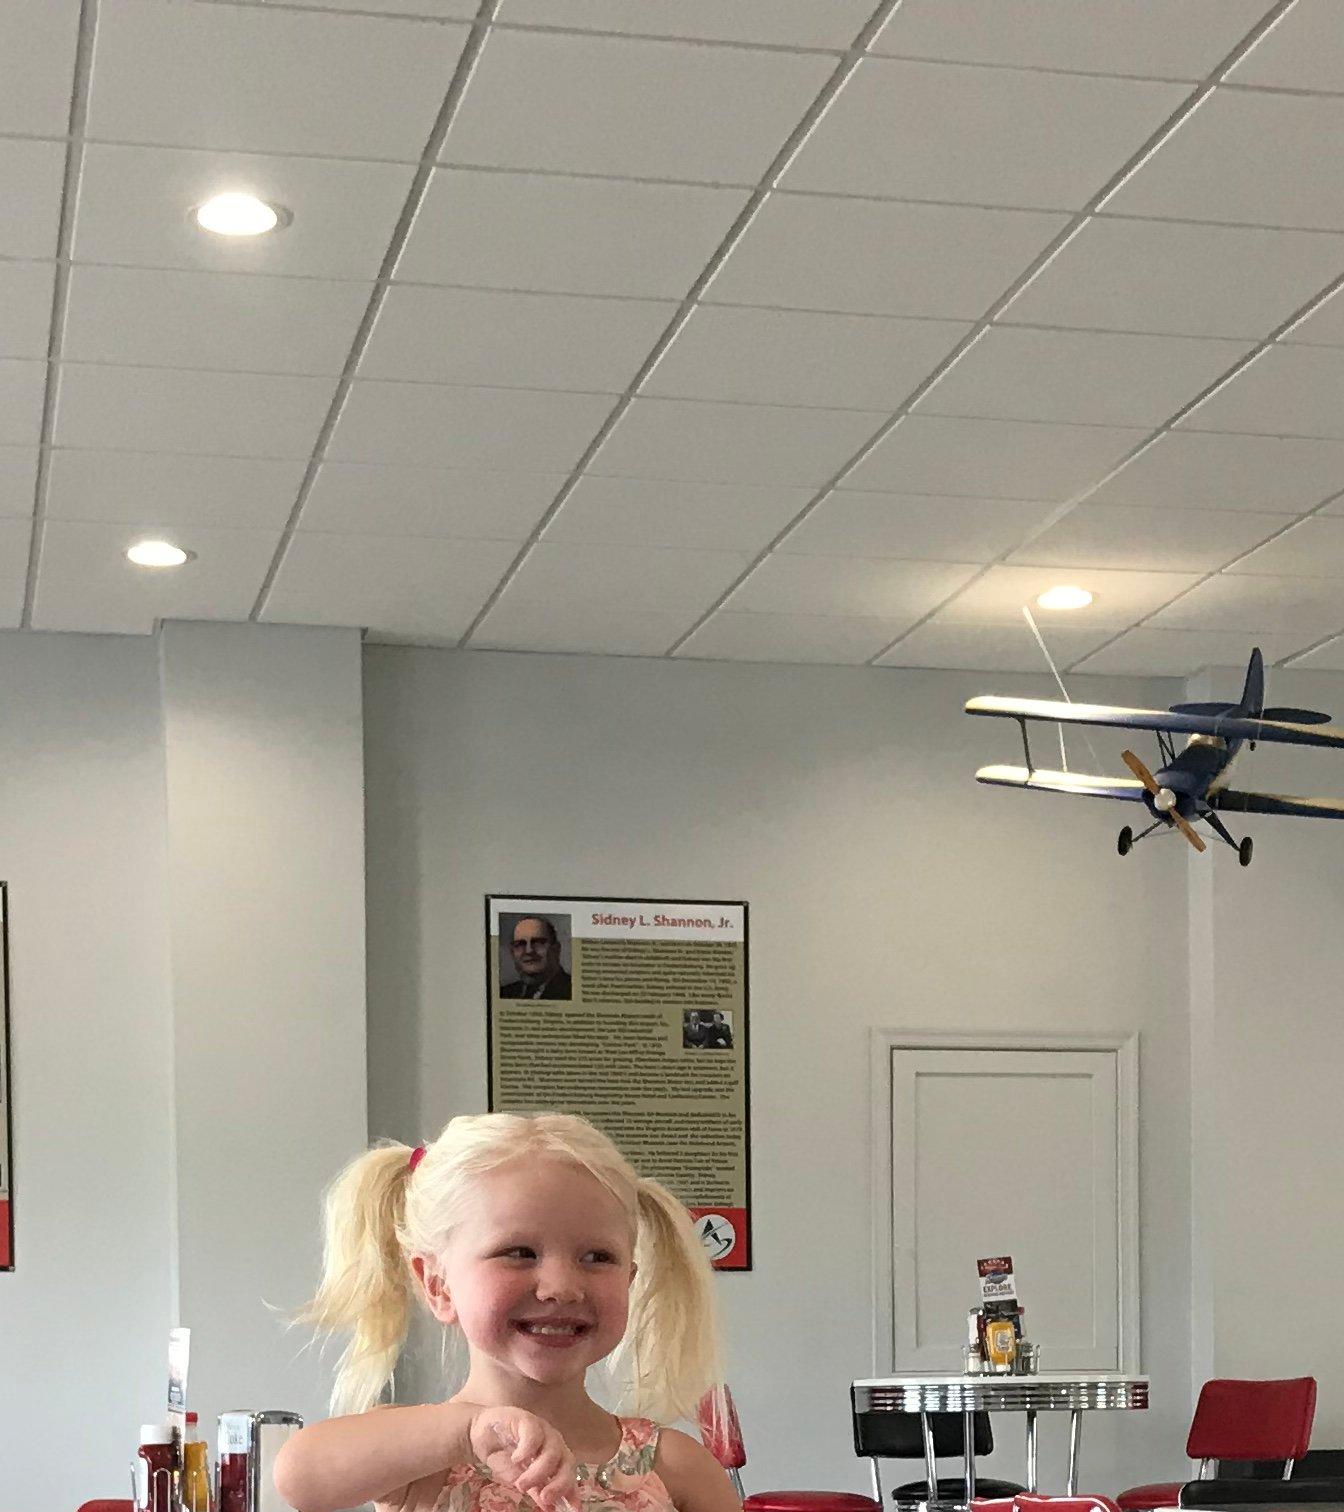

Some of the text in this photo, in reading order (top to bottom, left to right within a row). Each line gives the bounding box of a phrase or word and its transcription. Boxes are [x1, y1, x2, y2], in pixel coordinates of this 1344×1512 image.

[592, 913, 734, 929] Sidney L. Shannon, Jr.
